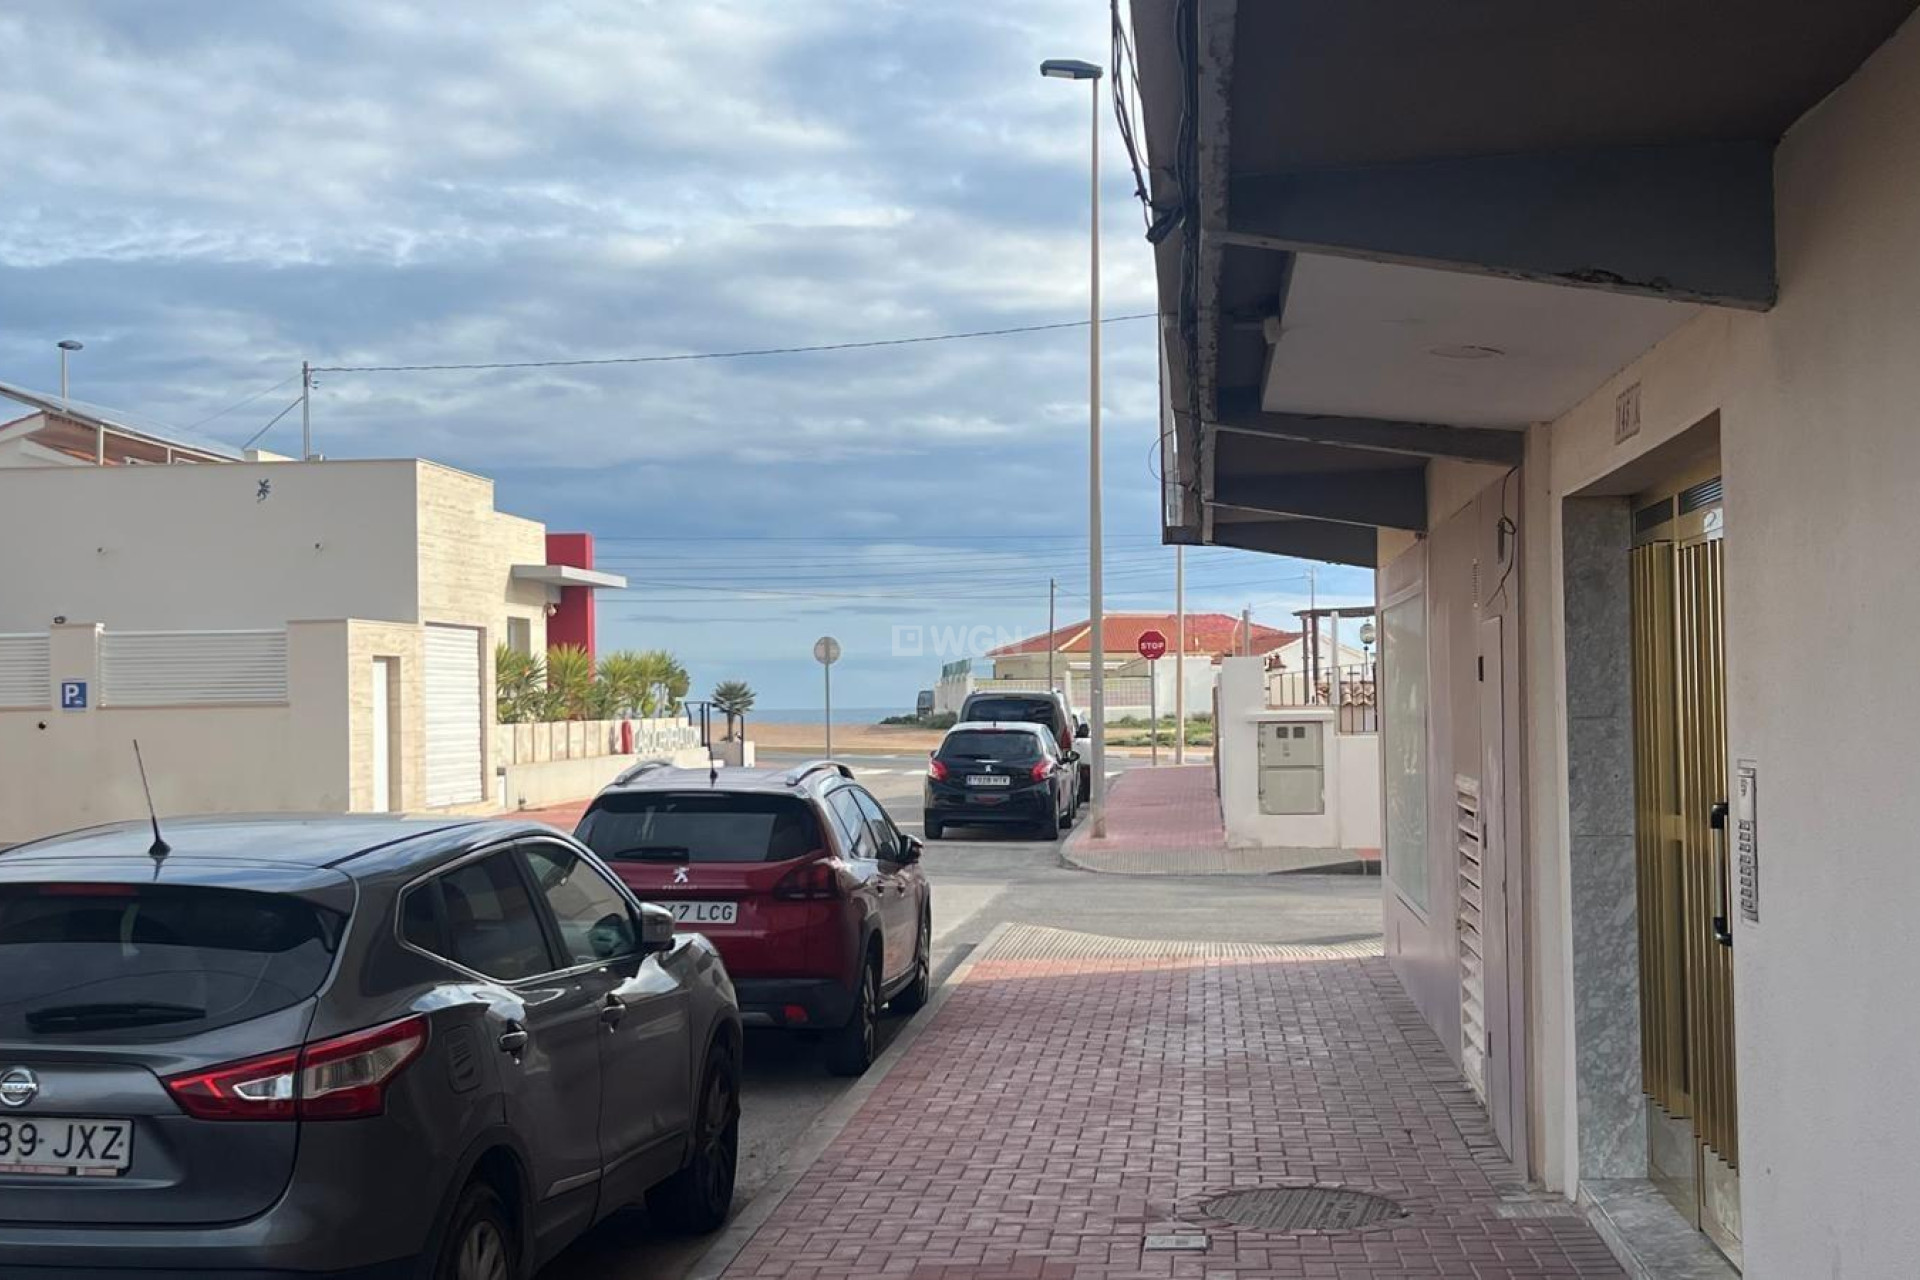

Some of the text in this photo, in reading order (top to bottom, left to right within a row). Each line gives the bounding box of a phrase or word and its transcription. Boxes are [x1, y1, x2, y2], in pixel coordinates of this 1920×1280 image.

[1140, 642, 1165, 650] STOP
[65, 684, 79, 705] P
[697, 905, 733, 921] LCG
[52, 1124, 123, 1160] JXZ
